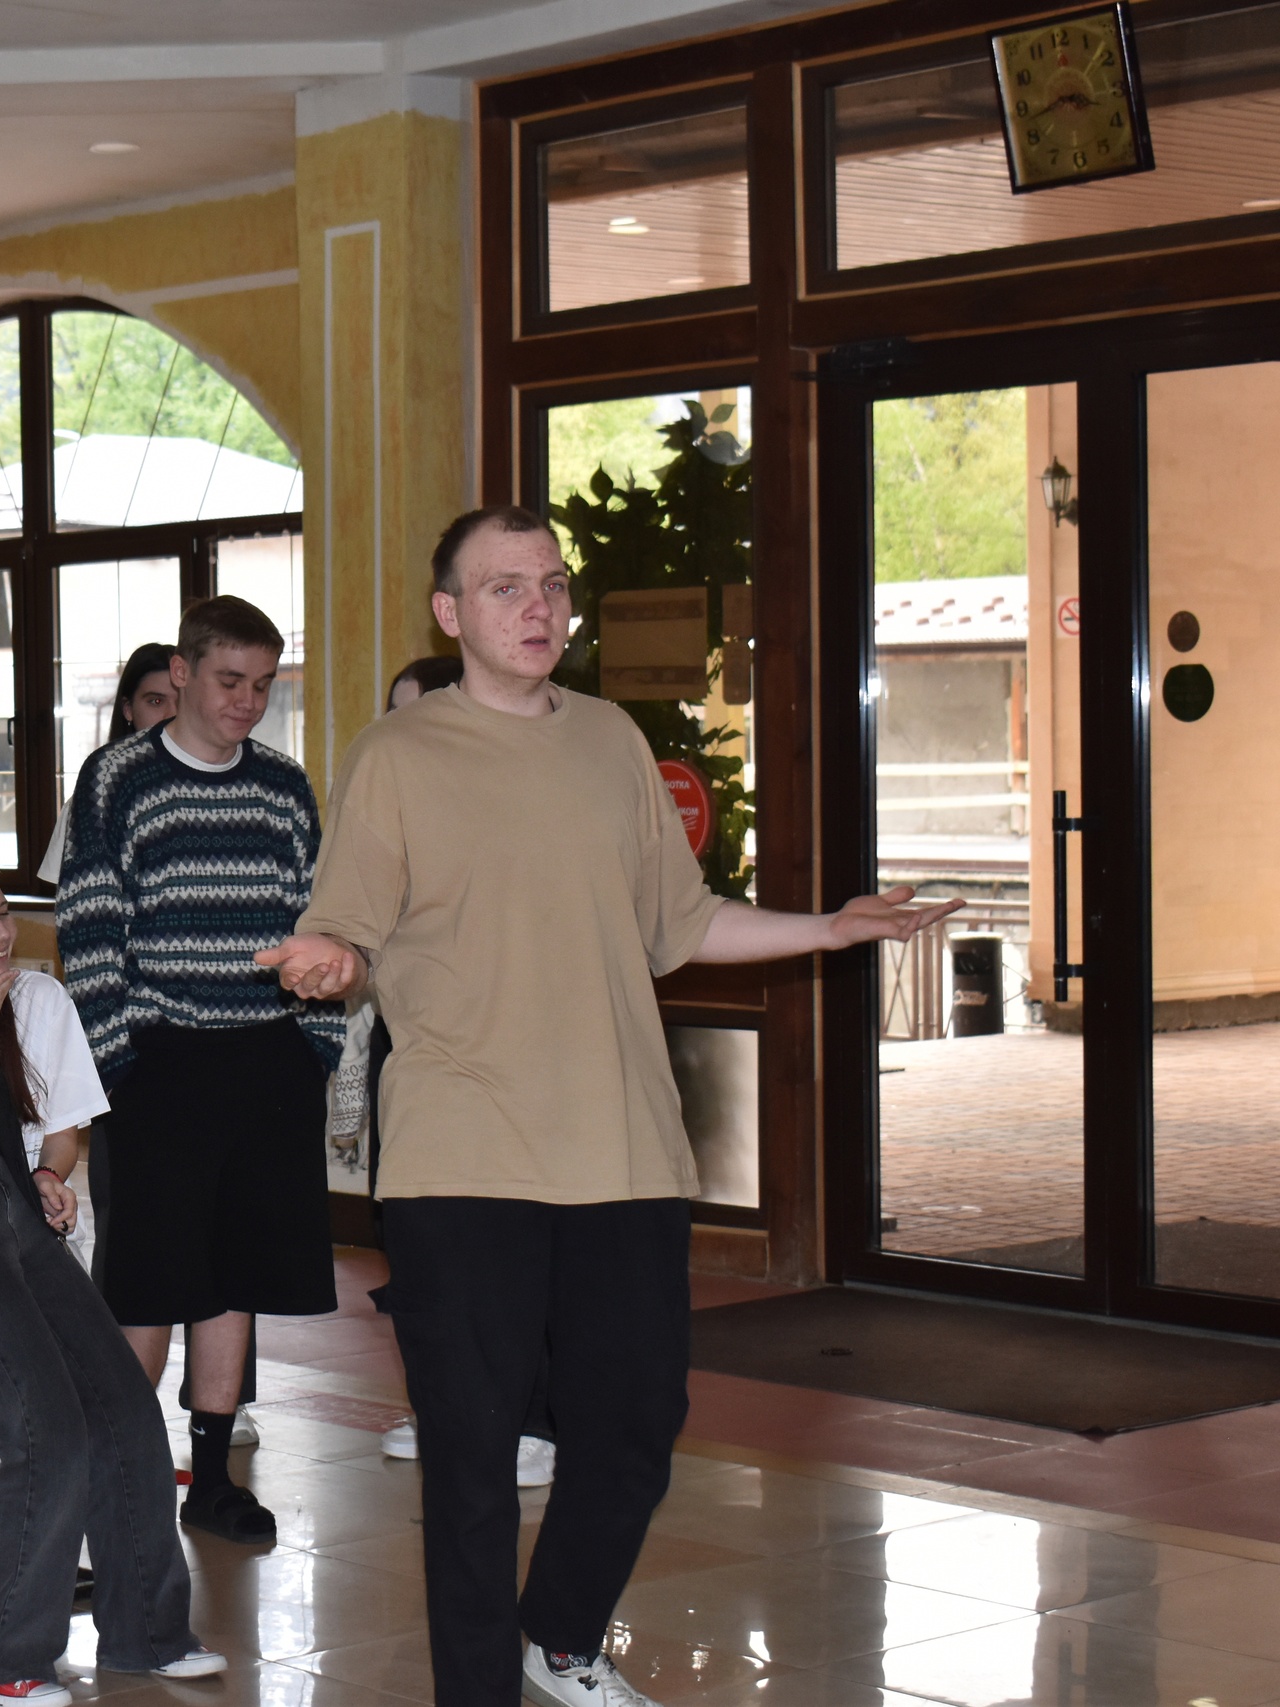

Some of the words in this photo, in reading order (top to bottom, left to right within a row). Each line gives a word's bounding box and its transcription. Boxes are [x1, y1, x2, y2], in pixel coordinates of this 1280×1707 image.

[1082, 34, 1090, 50] 1
[1030, 43, 1043, 61] 11
[1100, 52, 1115, 66] 2
[1017, 69, 1031, 86] 10
[1112, 81, 1124, 98] 3
[1016, 101, 1028, 118] 9
[1110, 111, 1123, 128] 4
[1026, 130, 1040, 145] 8
[1096, 140, 1109, 154] 5
[1047, 149, 1060, 165] 7
[1073, 151, 1087, 168] 6
